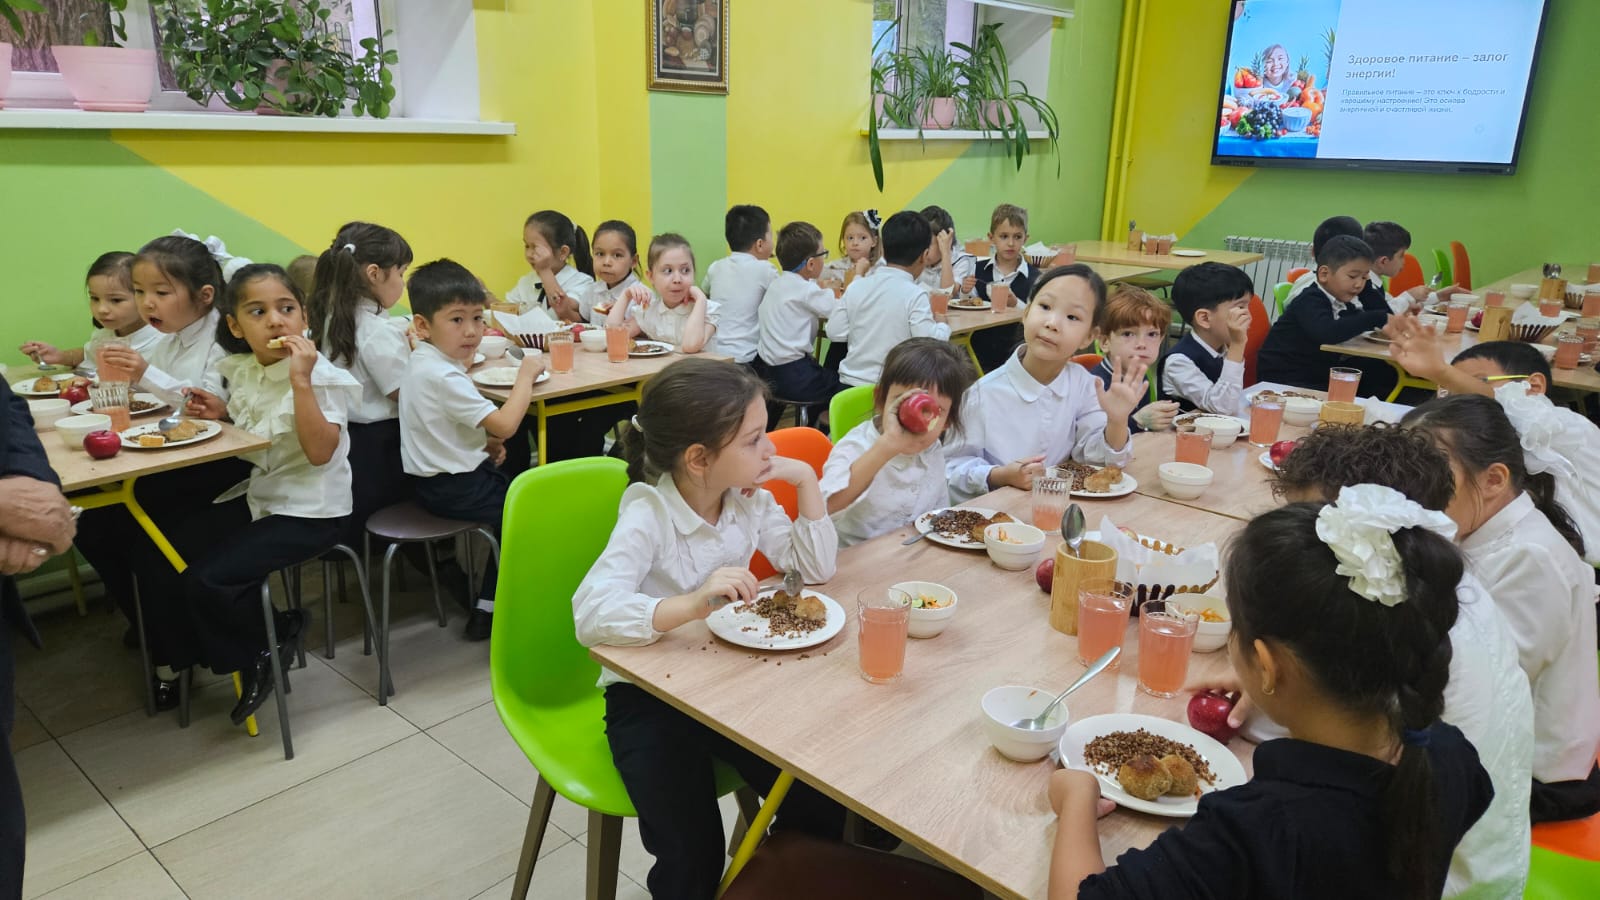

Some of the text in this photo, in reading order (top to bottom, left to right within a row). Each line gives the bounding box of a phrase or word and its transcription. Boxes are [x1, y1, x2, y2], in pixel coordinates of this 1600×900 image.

[1347, 54, 1405, 66] Здоровое
[1408, 54, 1459, 64] питание
[1472, 53, 1509, 63] залог
[1345, 68, 1396, 80] энергии!
[1462, 87, 1499, 96] бодрости
[1423, 96, 1438, 104] Это
